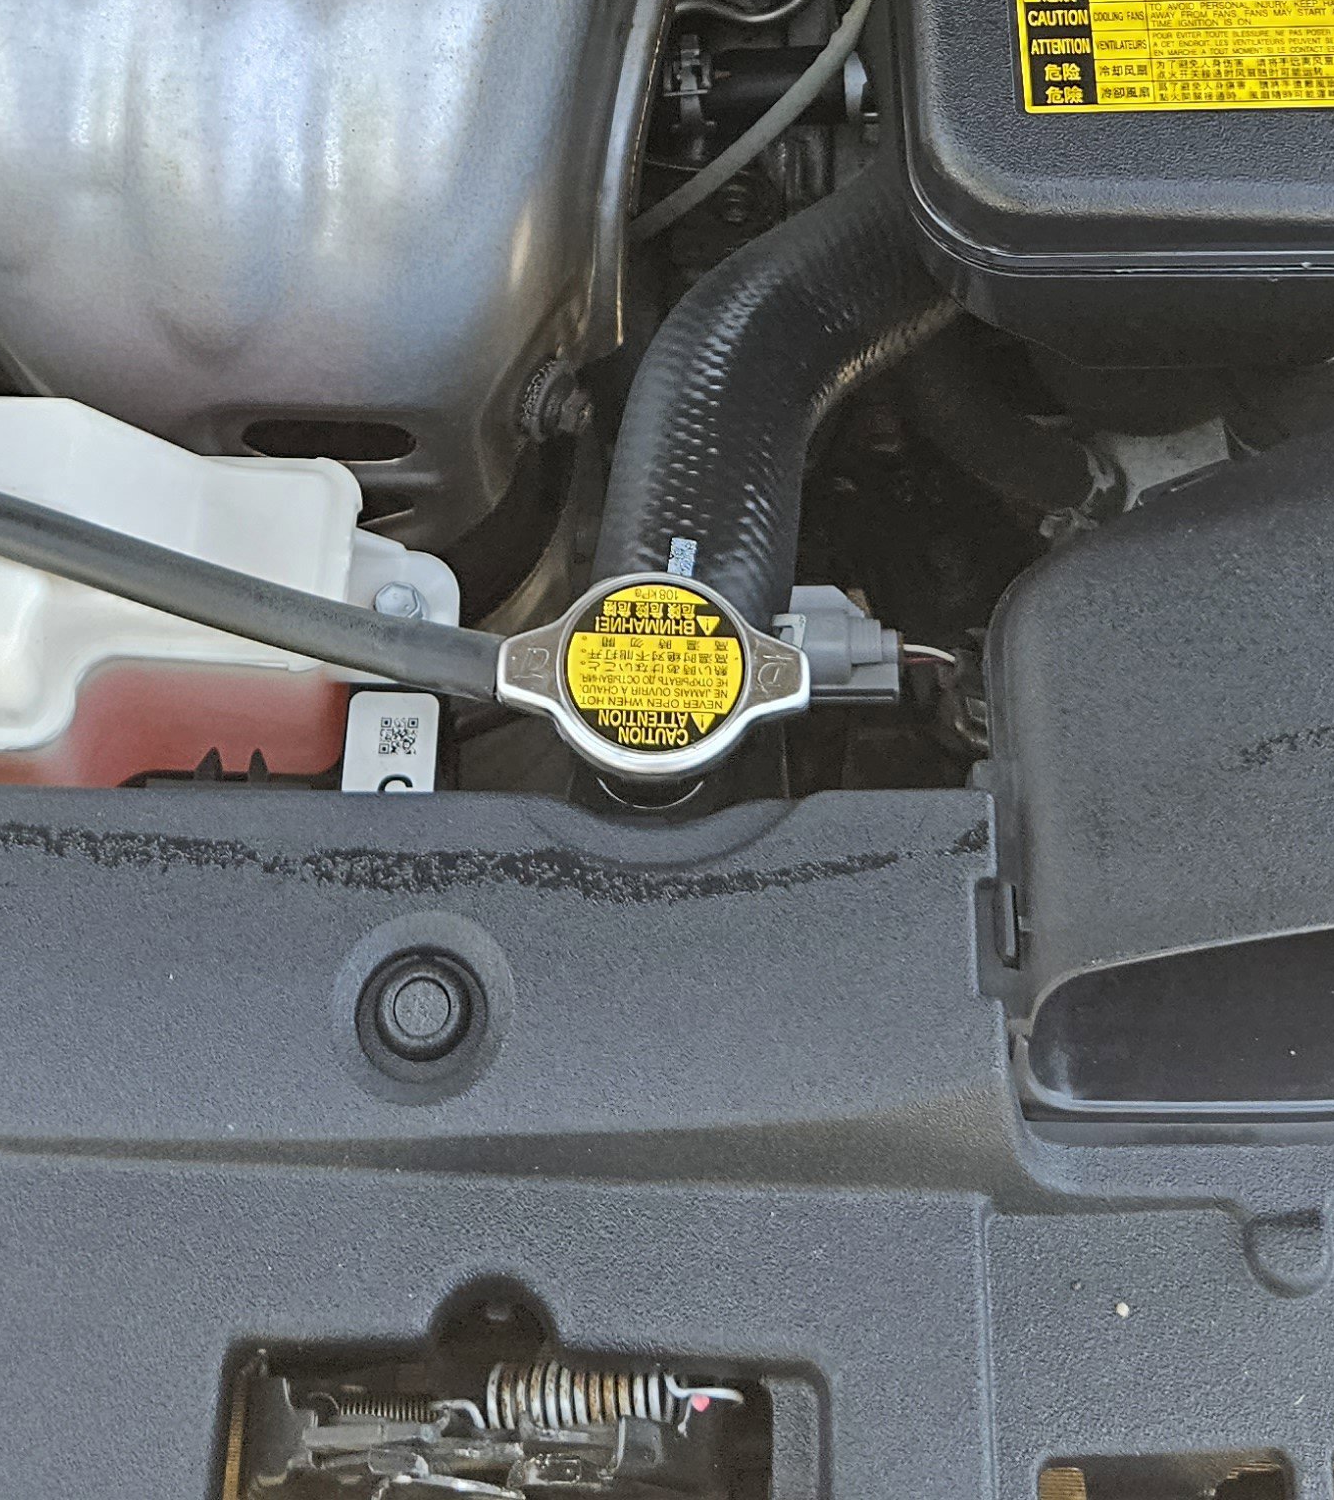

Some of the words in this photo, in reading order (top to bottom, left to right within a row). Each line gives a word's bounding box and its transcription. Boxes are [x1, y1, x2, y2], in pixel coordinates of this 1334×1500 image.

[1150, 3, 1162, 11] TO
[1168, 2, 1195, 11] AVOID
[1200, 1, 1250, 10] PERSONAL
[1294, 0, 1319, 8] KEEP
[1027, 9, 1088, 26] CAUTION
[1093, 12, 1124, 22] COOLING
[1127, 11, 1145, 21] FANS
[1150, 11, 1175, 20] AWAY
[1181, 10, 1208, 19] FROM
[1244, 9, 1269, 18] FANS
[1273, 9, 1293, 17] MAY
[1298, 8, 1327, 16] START
[1151, 19, 1173, 28] TIME
[1178, 18, 1219, 27] IGNITION
[1223, 18, 1233, 26] IS
[1031, 37, 1091, 55] ATTENTION
[1096, 39, 1147, 51] VENTILATEURS
[1044, 62, 1081, 82] 危险
[595, 616, 696, 635] ВНИМАНИЕ!
[643, 675, 656, 685] ДО
[658, 676, 714, 687] ОТКРЫВАТЬ
[718, 678, 729, 688] НЕ
[579, 684, 618, 695] CHAUD.
[631, 686, 671, 697] OUVRIR
[674, 688, 711, 698] JAMAIS
[716, 689, 728, 699] NE
[579, 695, 605, 705] HOT.
[608, 697, 643, 707] WHEN
[647, 699, 679, 709] OPEN
[684, 700, 723, 710] NEVER
[598, 709, 688, 728] ATTENTION
[618, 726, 689, 746] CAUTION
